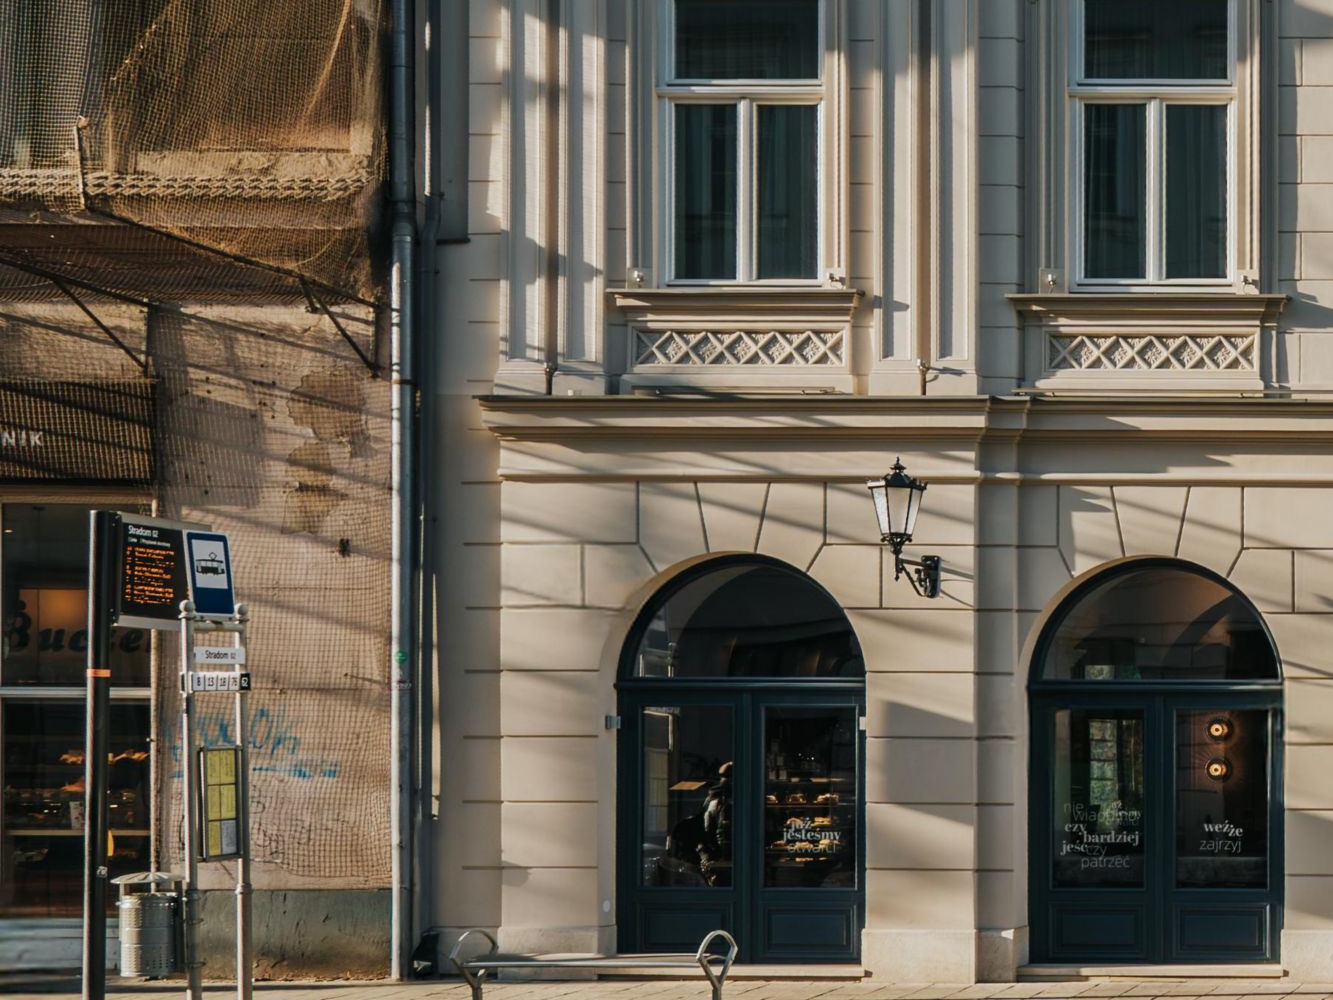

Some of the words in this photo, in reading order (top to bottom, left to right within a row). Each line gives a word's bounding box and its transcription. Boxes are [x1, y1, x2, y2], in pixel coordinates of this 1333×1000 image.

[128, 525, 152, 537] Stradom
[205, 649, 229, 659] Stradom
[783, 827, 841, 844] jesteśmy
[1064, 823, 1087, 836] czy
[1083, 830, 1139, 846] bardziej
[1199, 839, 1242, 853] zajrzyj
